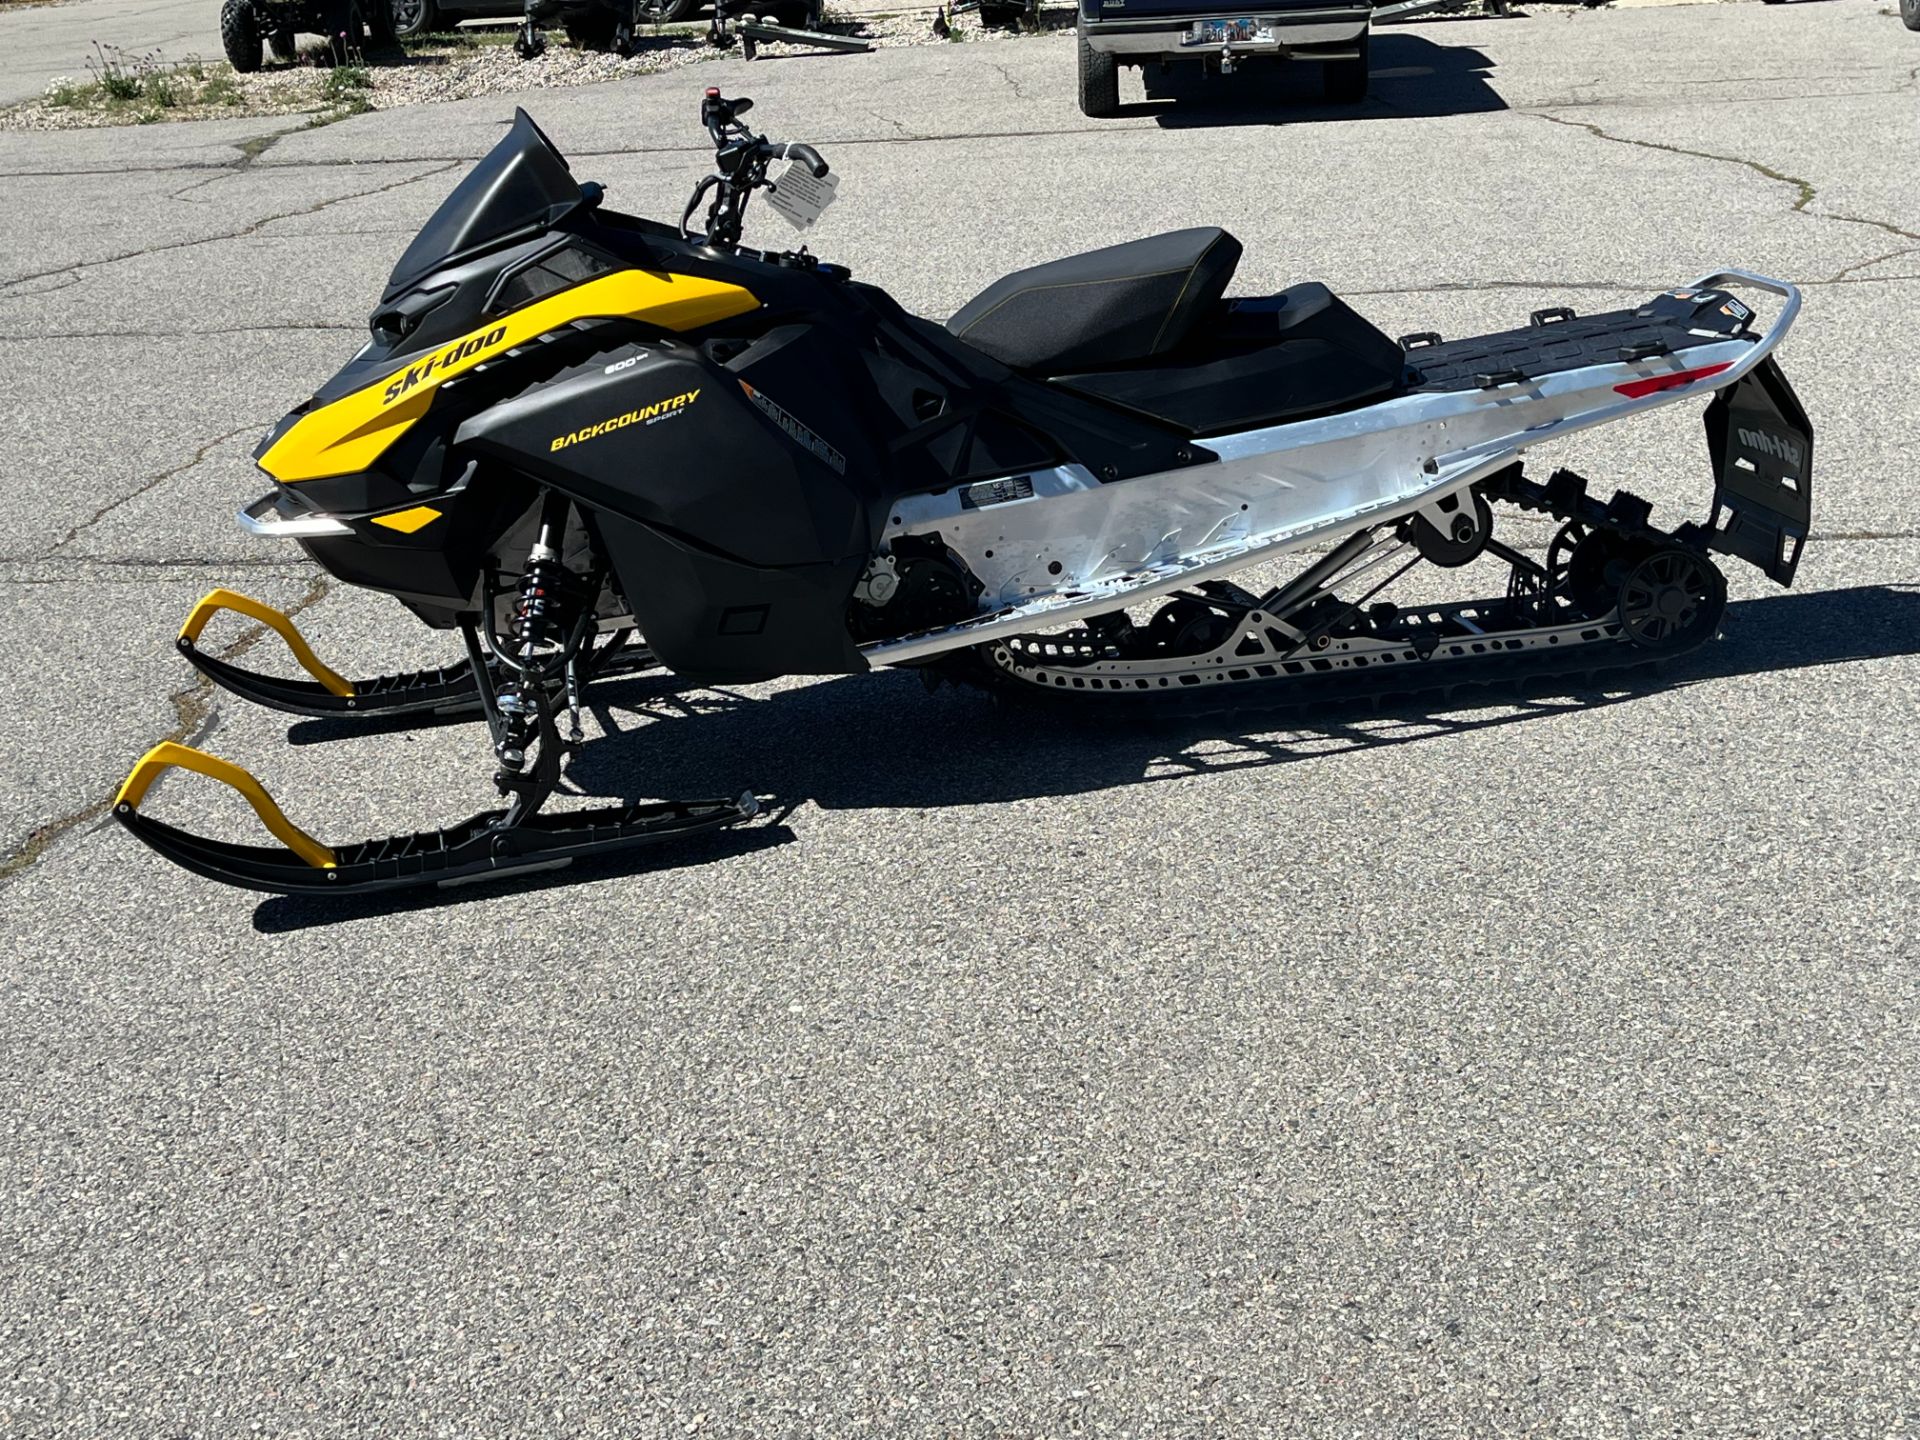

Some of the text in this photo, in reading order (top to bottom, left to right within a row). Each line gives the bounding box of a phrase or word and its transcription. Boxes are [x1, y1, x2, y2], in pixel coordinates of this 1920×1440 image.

[383, 325, 507, 405] ski-doo
[550, 388, 701, 452] BACKCOUNTRY
[646, 408, 684, 426] SPORT
